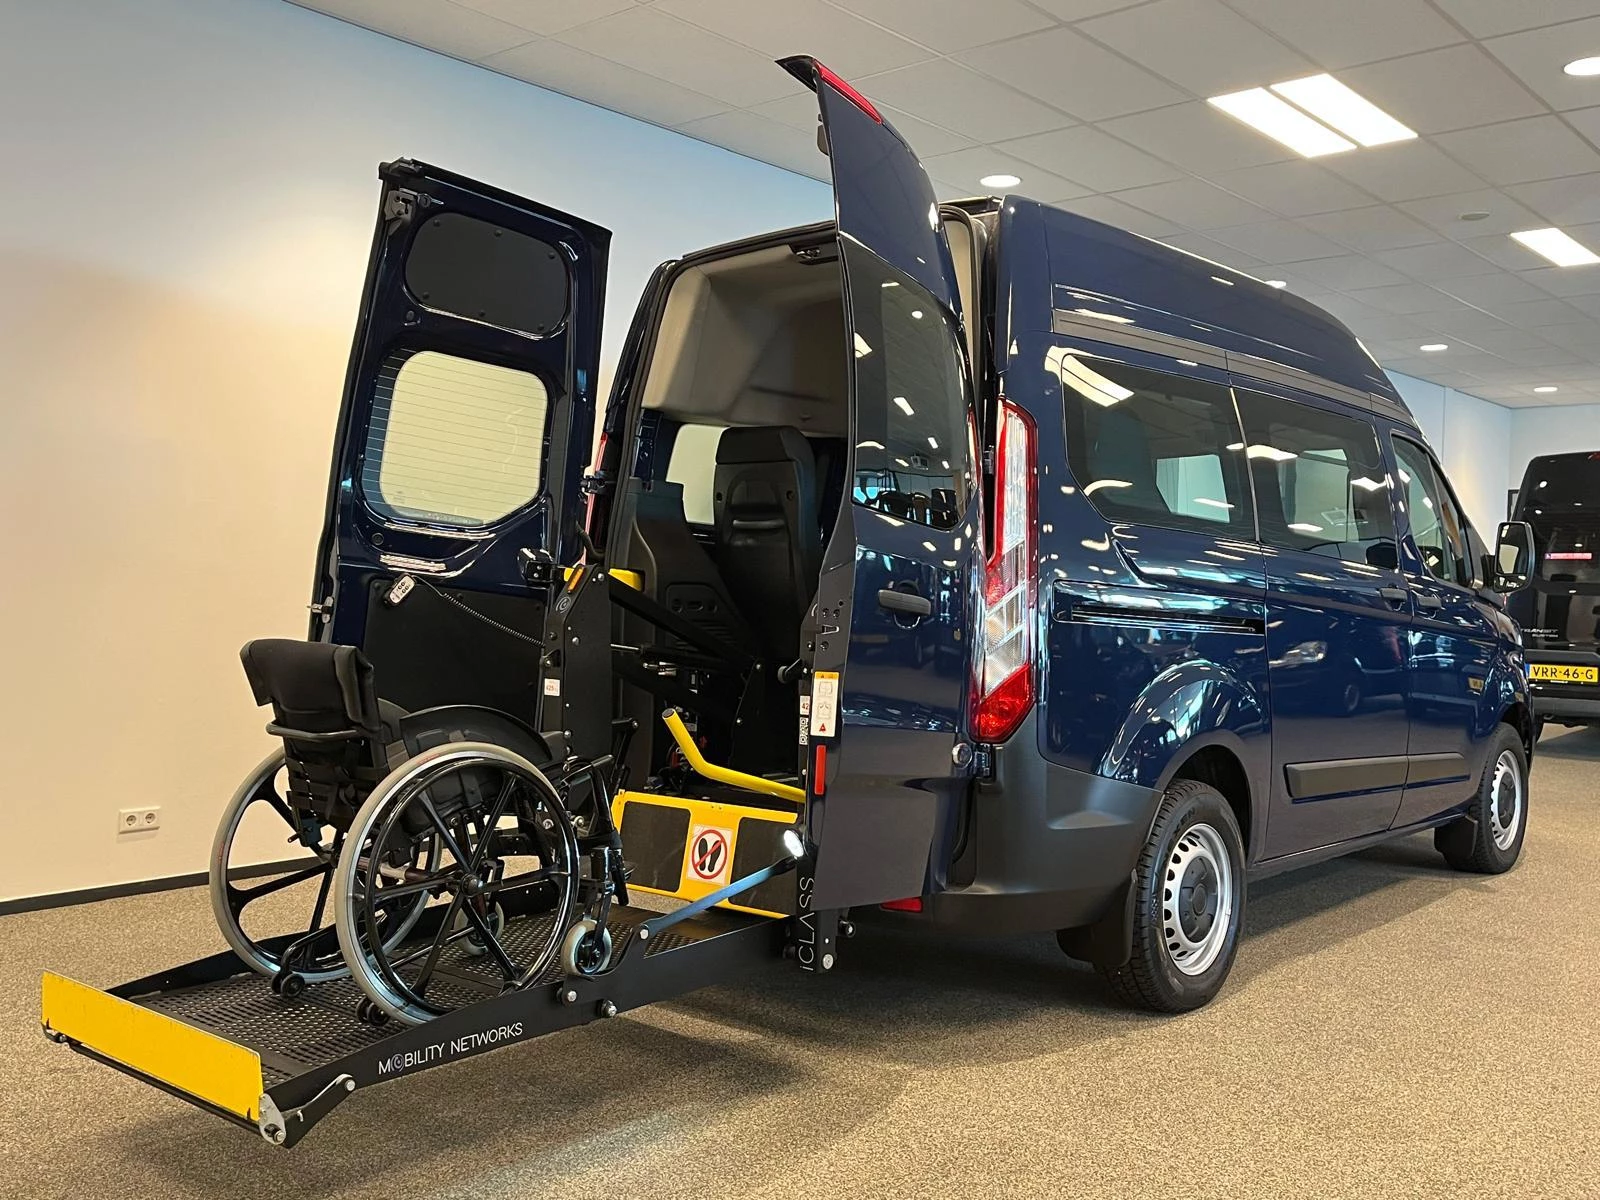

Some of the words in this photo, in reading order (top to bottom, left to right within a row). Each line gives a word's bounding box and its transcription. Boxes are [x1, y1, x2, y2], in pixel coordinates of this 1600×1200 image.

[1532, 666, 1594, 680] VRR-46-G
[378, 1042, 446, 1075] MOBILITY
[450, 1022, 523, 1055] NETWORKS
